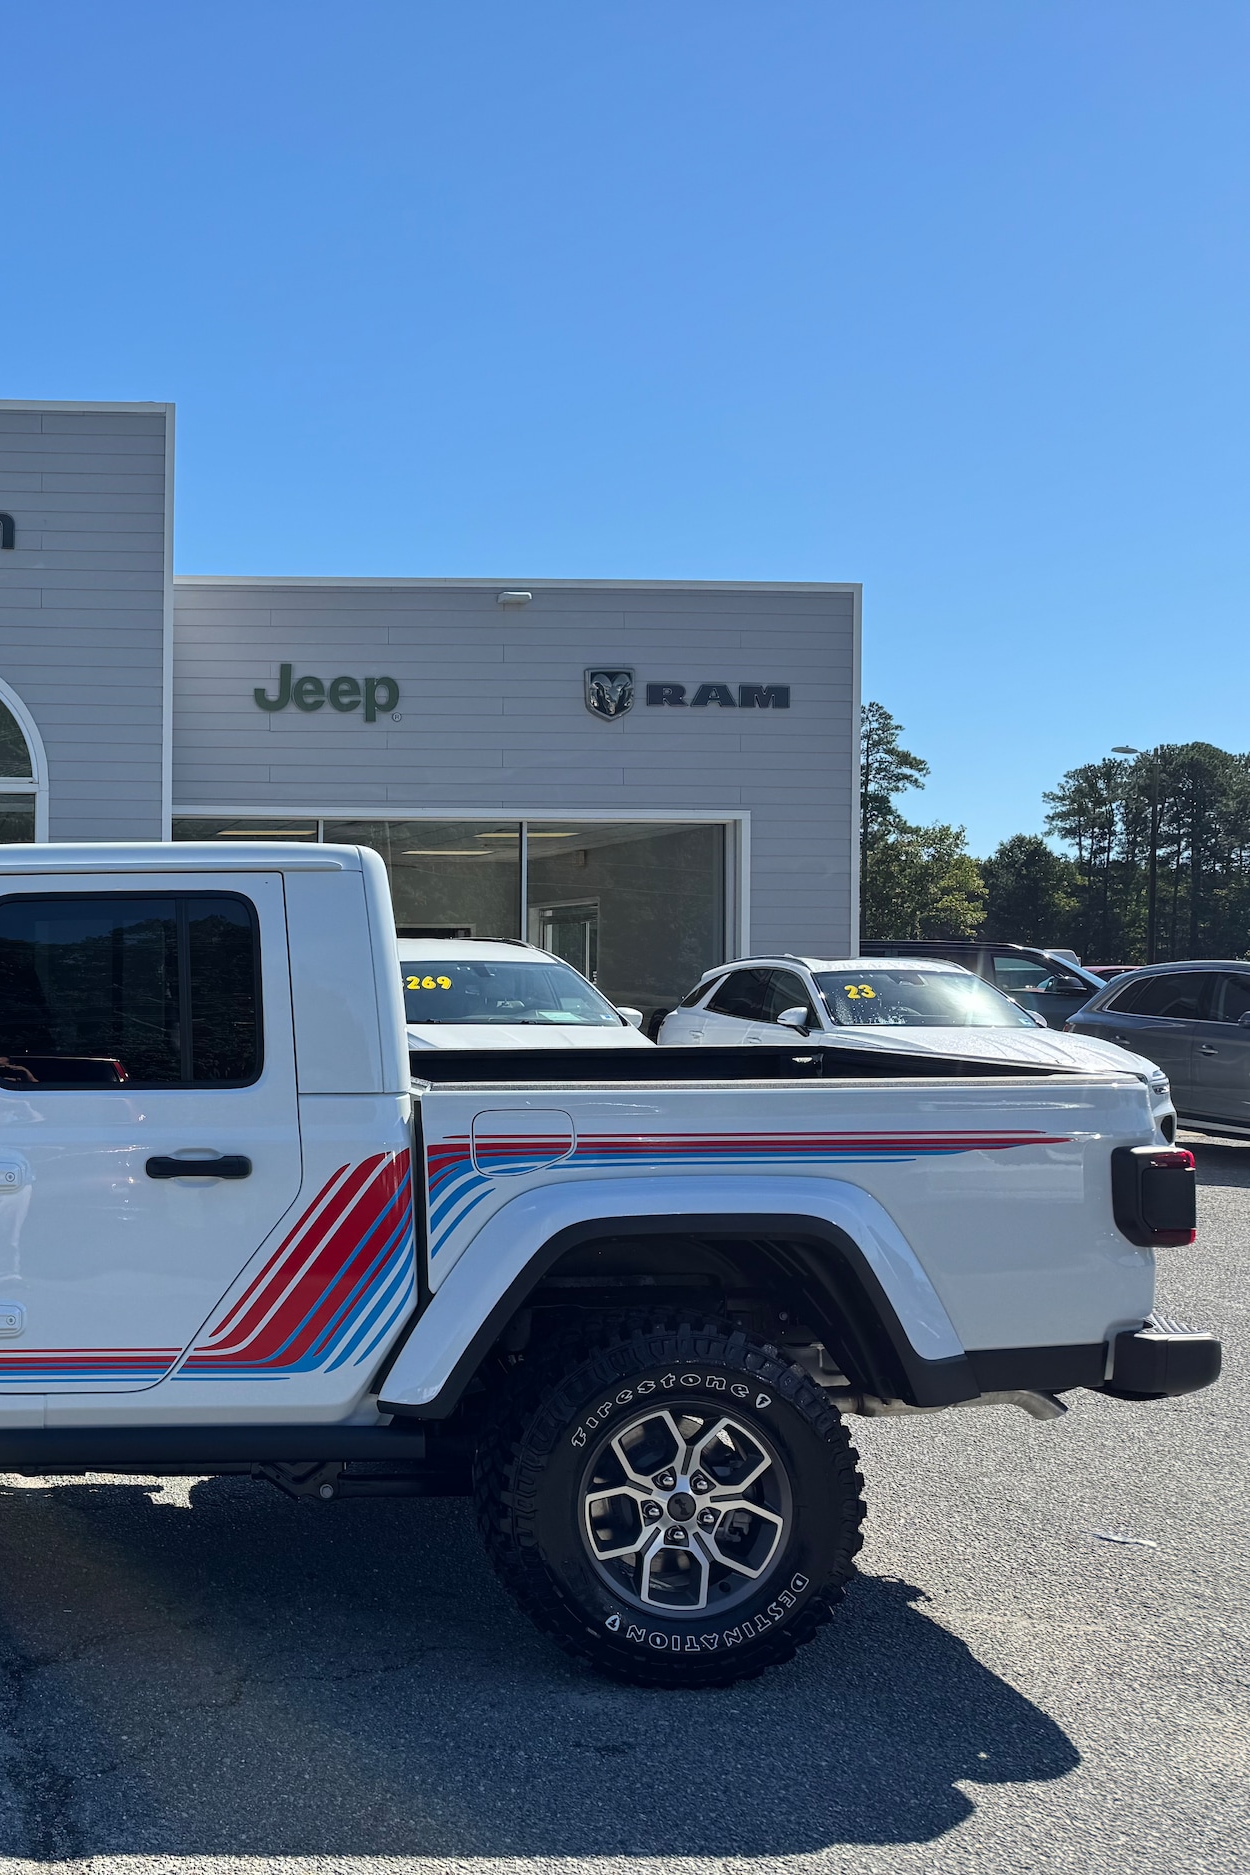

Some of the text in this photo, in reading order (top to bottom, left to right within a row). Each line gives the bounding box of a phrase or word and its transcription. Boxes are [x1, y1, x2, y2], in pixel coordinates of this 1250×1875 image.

[254, 663, 400, 722] Jeep
[646, 683, 791, 709] RAM
[402, 975, 452, 990] 269
[844, 984, 876, 999] 23
[571, 1373, 750, 1449] Firestone
[626, 1573, 810, 1652] DESTINATION
